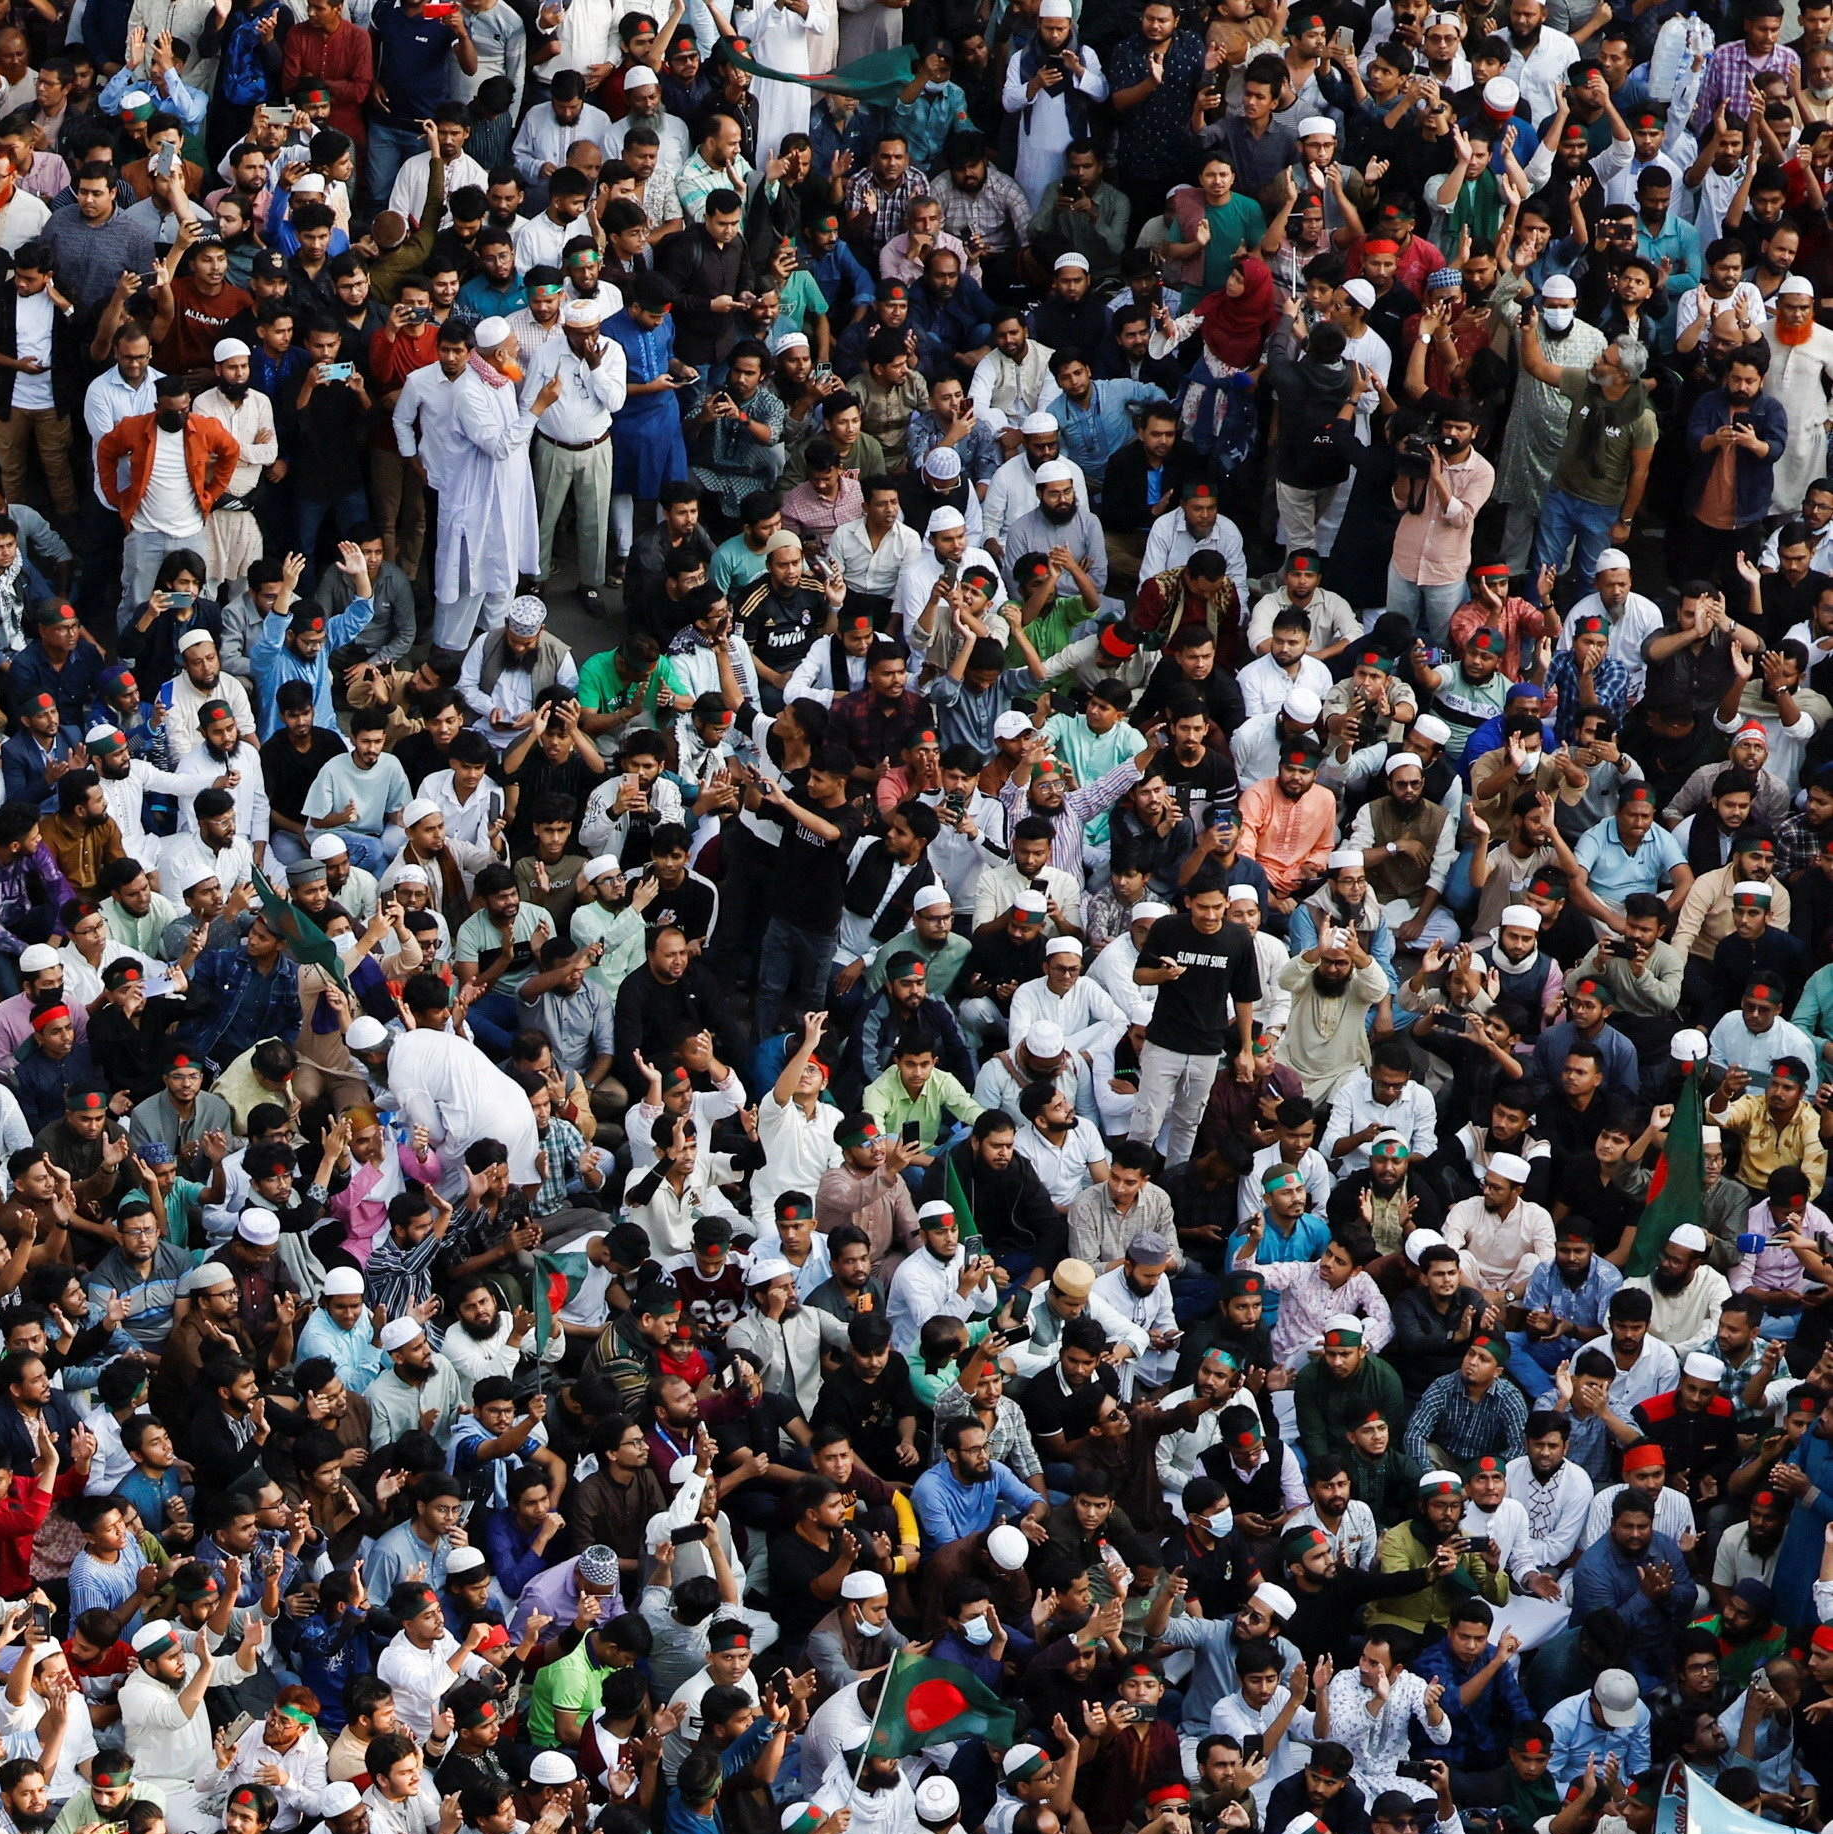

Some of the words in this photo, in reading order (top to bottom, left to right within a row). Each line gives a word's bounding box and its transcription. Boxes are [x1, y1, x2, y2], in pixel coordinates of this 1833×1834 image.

[1176, 950, 1198, 963] SLOW
[1196, 953, 1213, 965] BUT
[1210, 955, 1229, 968] SURE
